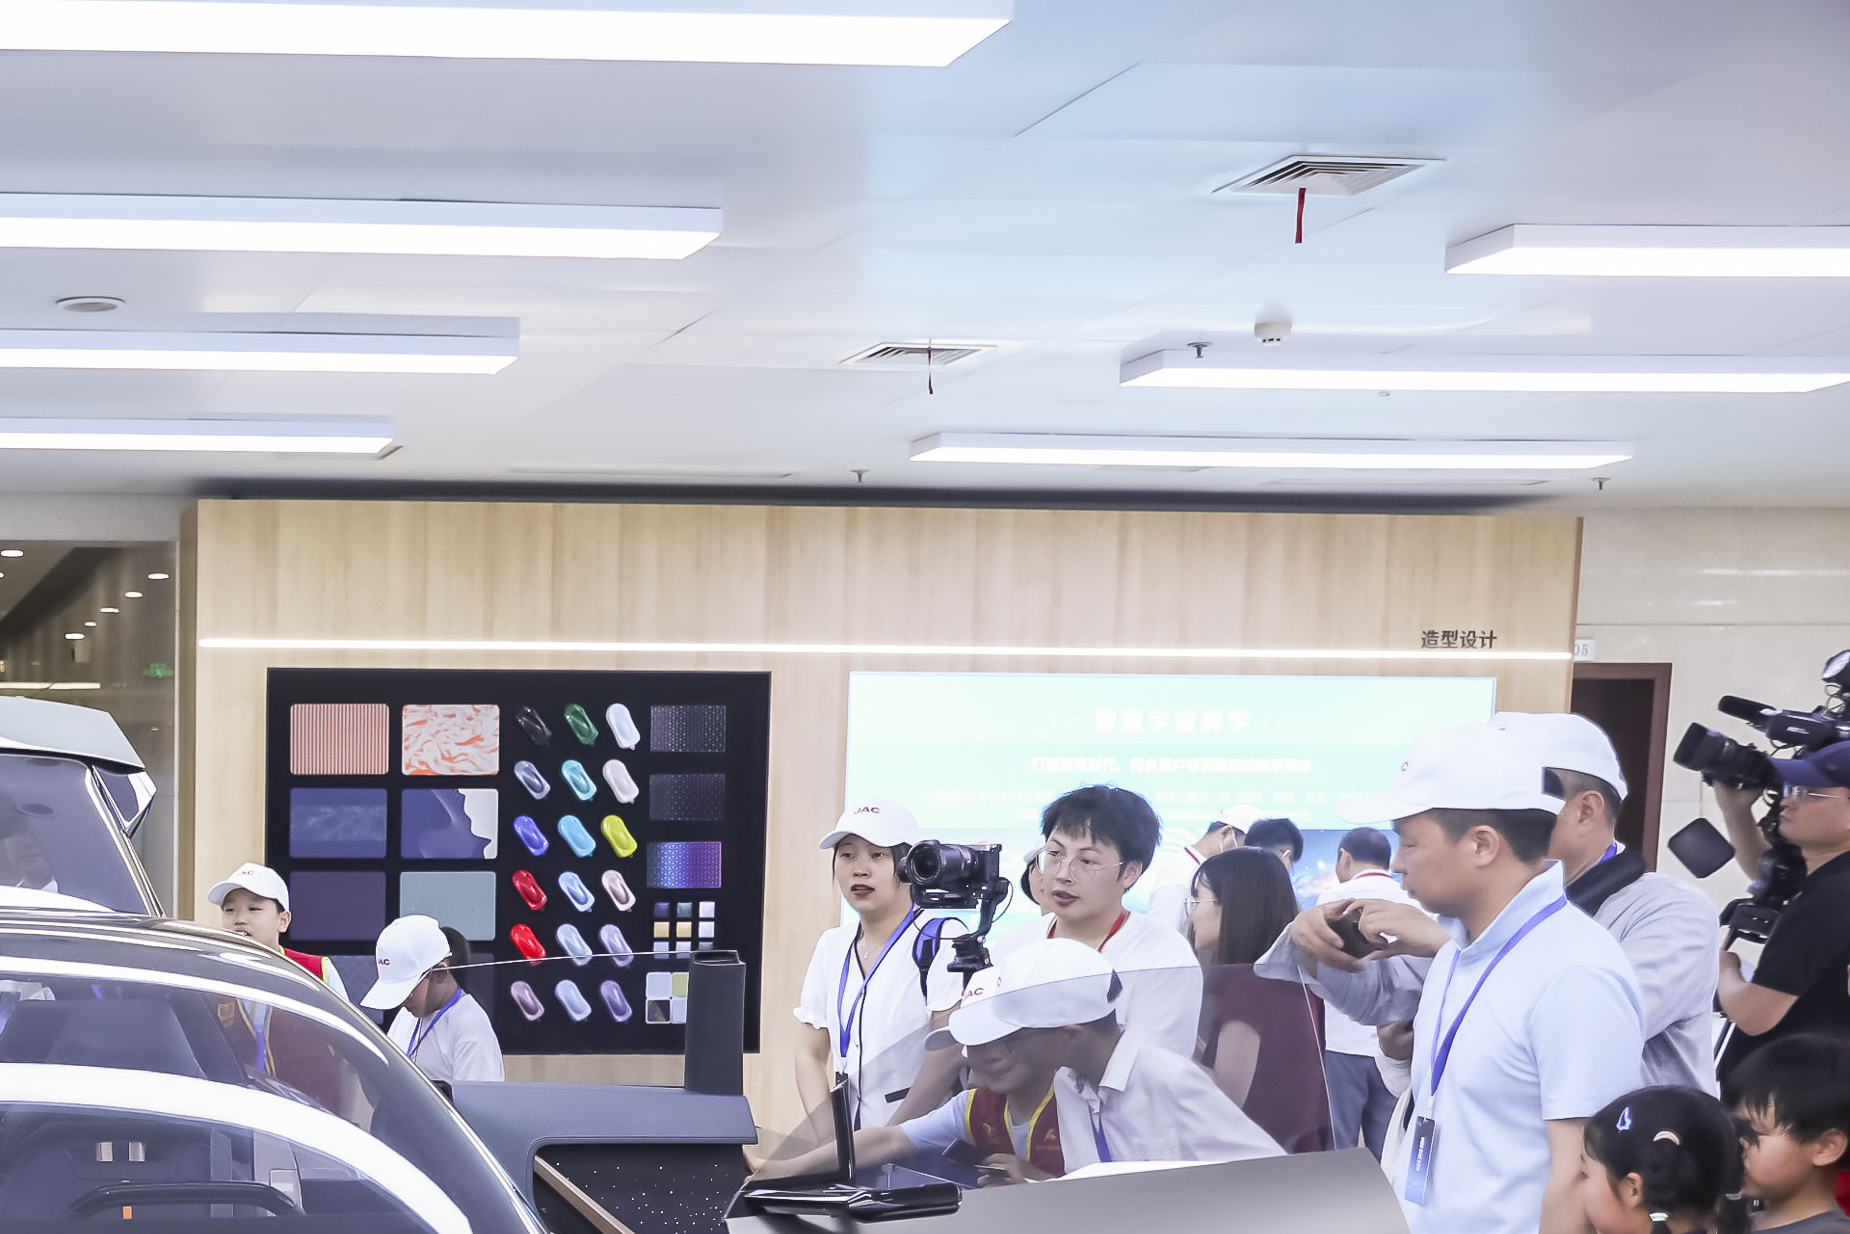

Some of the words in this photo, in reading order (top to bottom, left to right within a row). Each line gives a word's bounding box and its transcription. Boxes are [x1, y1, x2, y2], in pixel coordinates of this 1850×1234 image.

[1421, 630, 1498, 649] 造型设计
[854, 806, 880, 815] JAC
